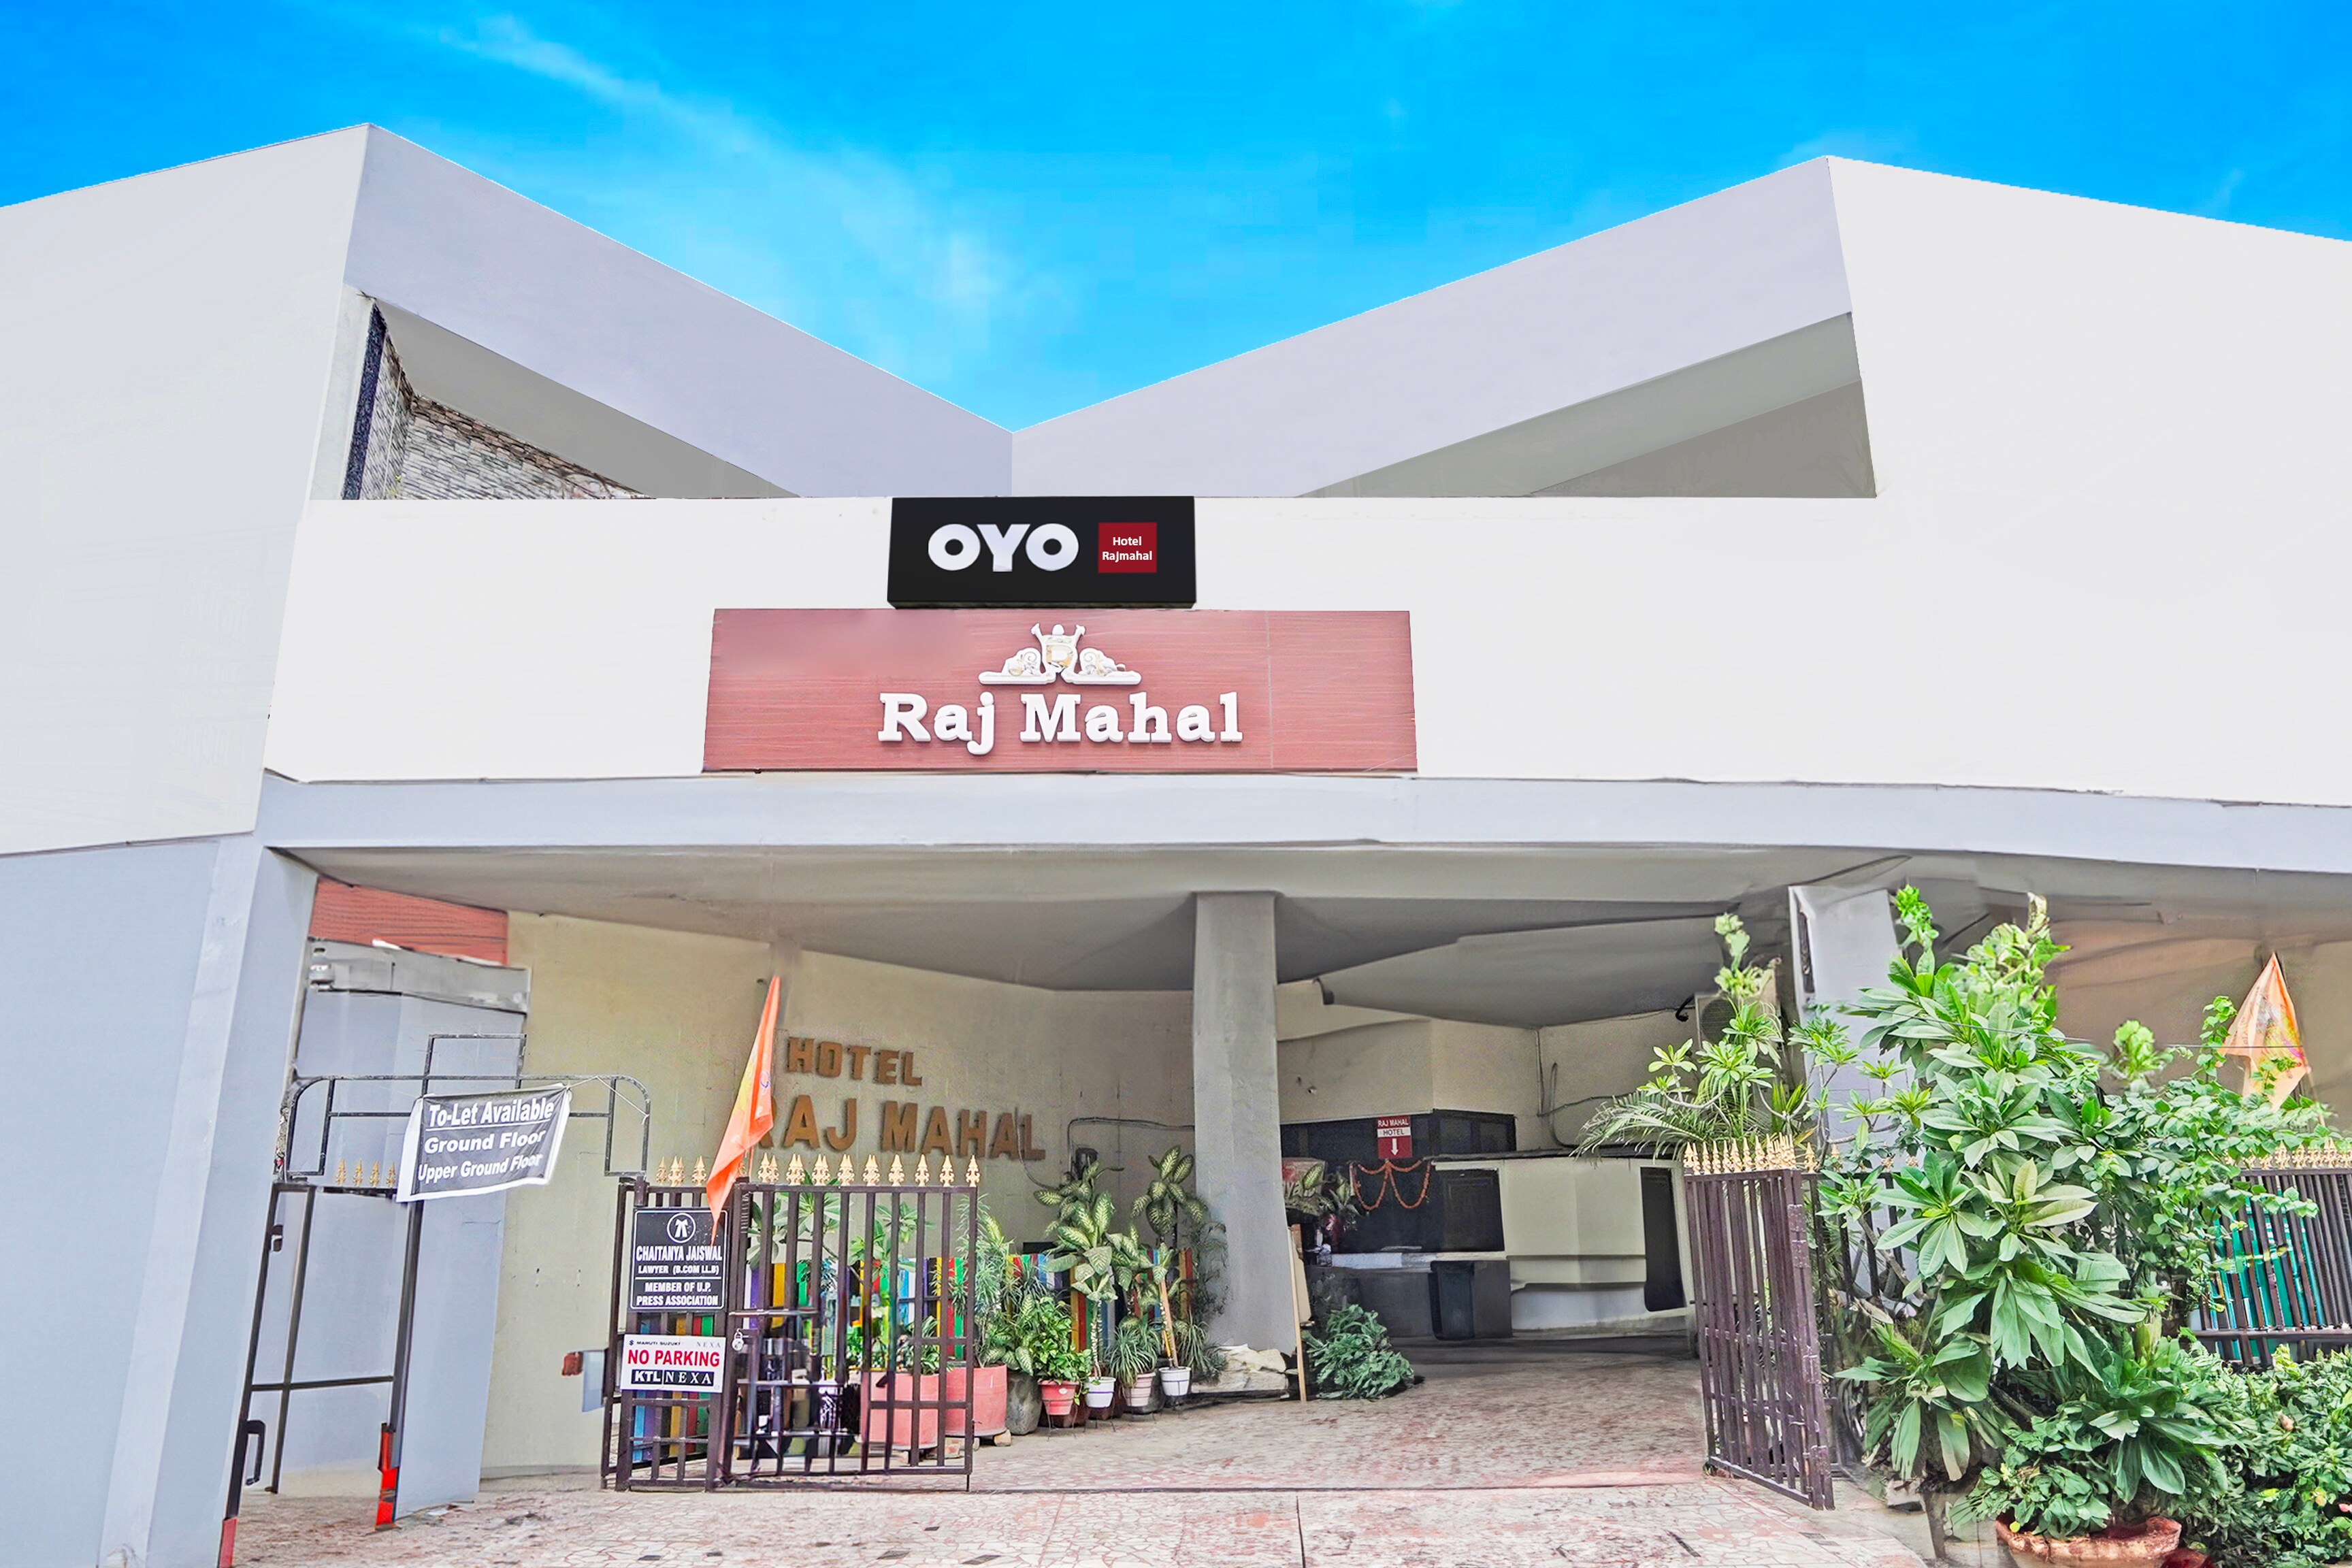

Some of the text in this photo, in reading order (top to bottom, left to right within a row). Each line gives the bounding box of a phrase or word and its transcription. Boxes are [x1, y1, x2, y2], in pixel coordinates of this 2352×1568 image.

[928, 523, 1079, 572] OYO
[1113, 536, 1142, 546] Hotel
[877, 690, 1243, 756] Raj Mahal
[787, 1036, 923, 1086] HOTEL
[429, 1098, 555, 1127] To-Let Available
[758, 1094, 1046, 1160] AJ MAHAL
[1389, 1118, 1409, 1126] MAHAL
[424, 1130, 546, 1154] Ground Floor
[418, 1154, 544, 1184] Upper Ground Floor
[636, 1245, 722, 1261] CHAITANYA JAISWAL
[638, 1265, 668, 1274] LAWYER
[645, 1282, 711, 1292] MEMBER OF U.P.
[636, 1296, 718, 1306] PRESS ASSOCIATION
[628, 1350, 720, 1367] NO PARKING
[634, 1371, 712, 1384] KTL NEXA
